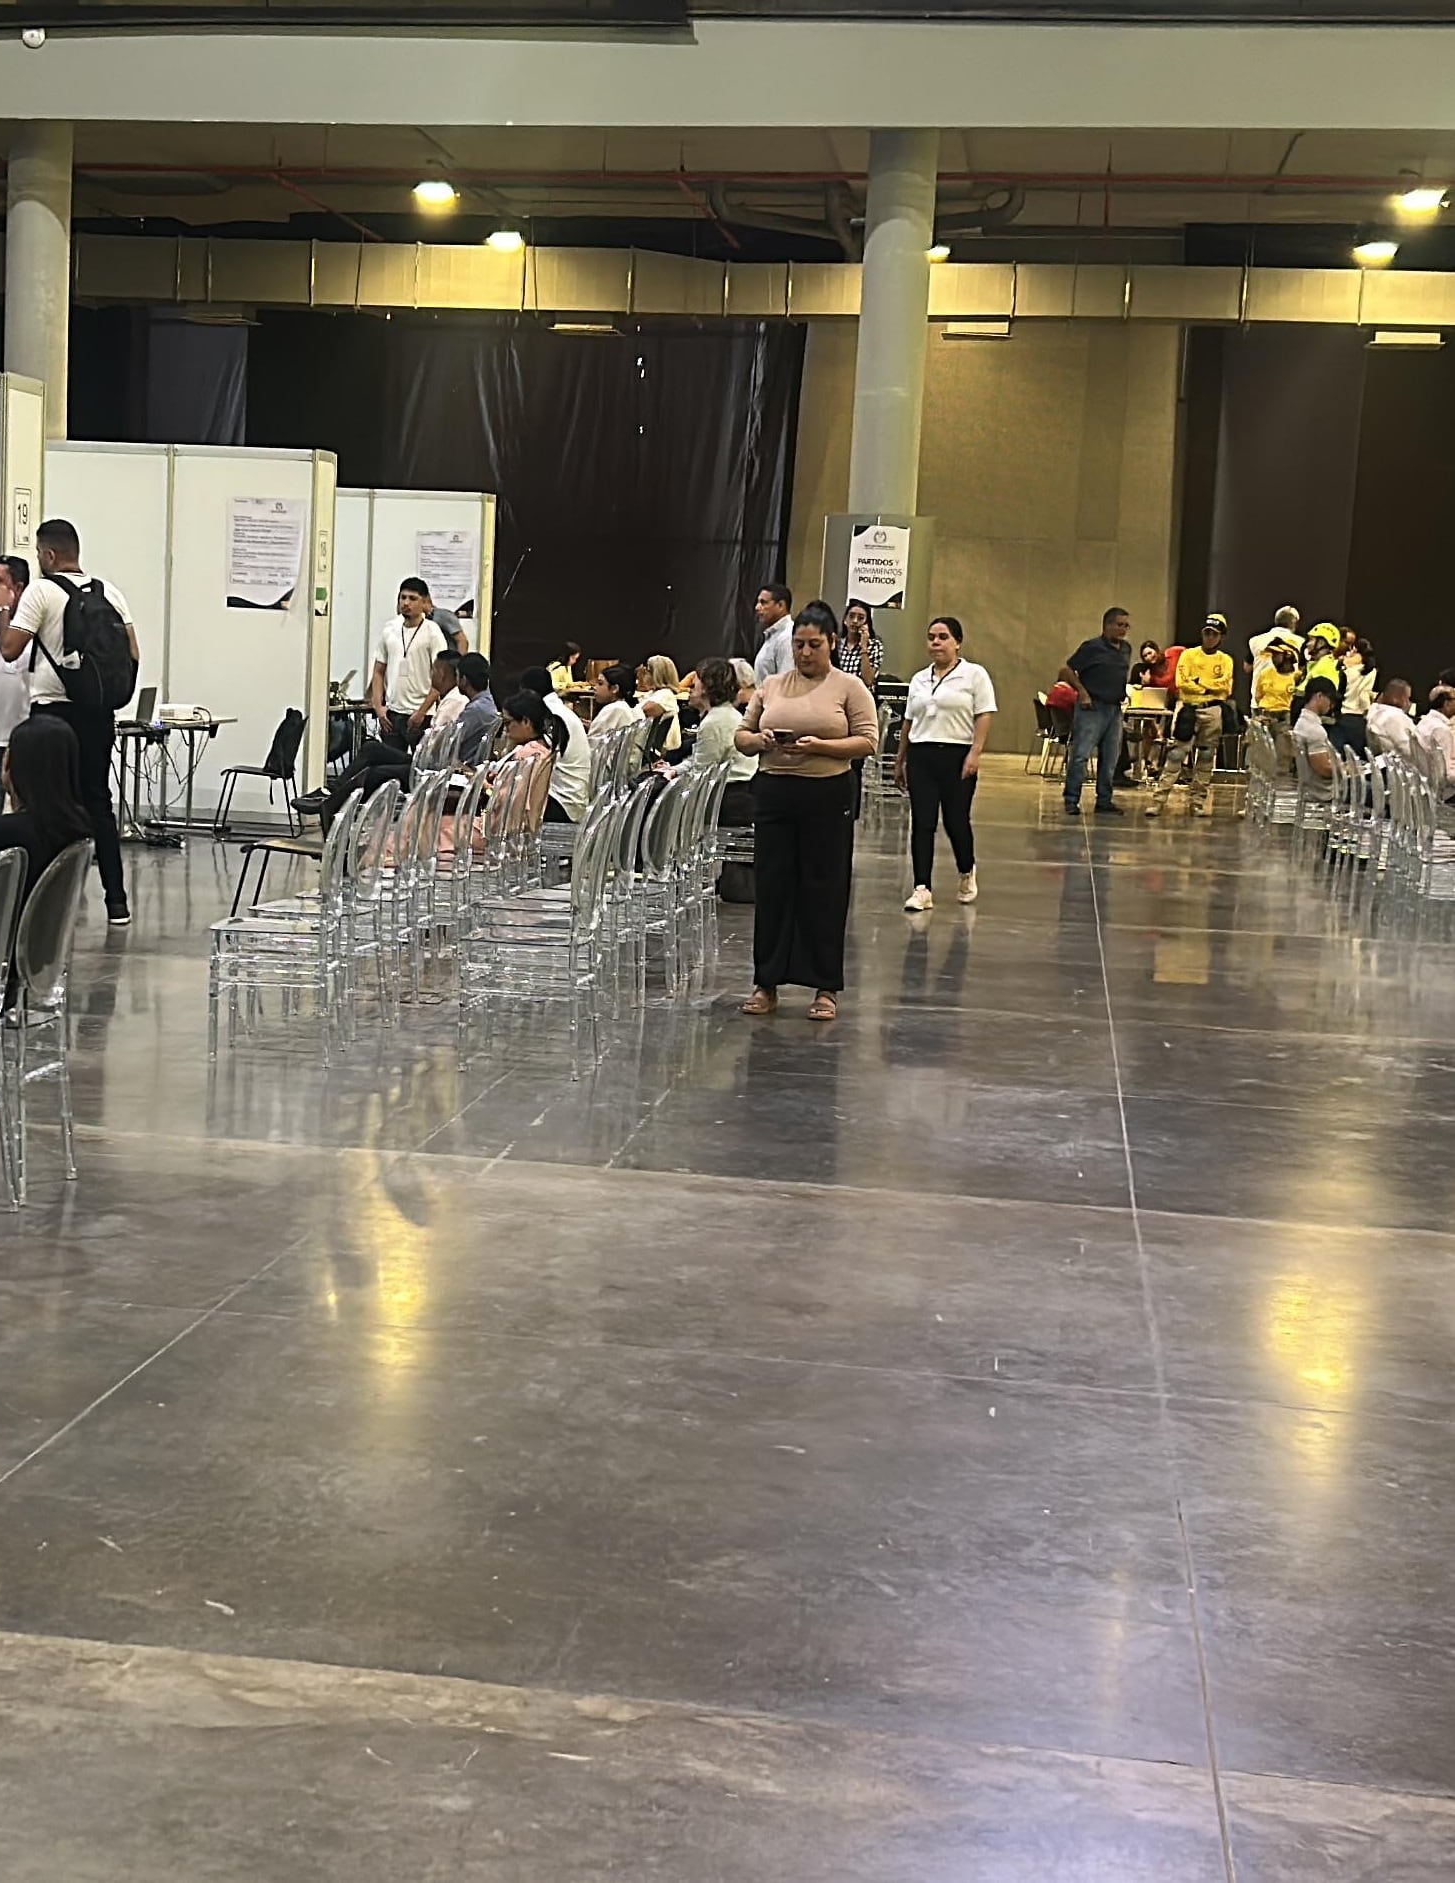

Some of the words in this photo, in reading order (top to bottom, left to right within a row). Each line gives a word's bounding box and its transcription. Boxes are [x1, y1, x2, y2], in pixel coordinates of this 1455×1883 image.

[17, 503, 28, 525] 19
[857, 558, 894, 567] PARTIDOS
[853, 567, 903, 577] MOVIMIENTOS
[858, 575, 896, 585] POLÍTICOS
